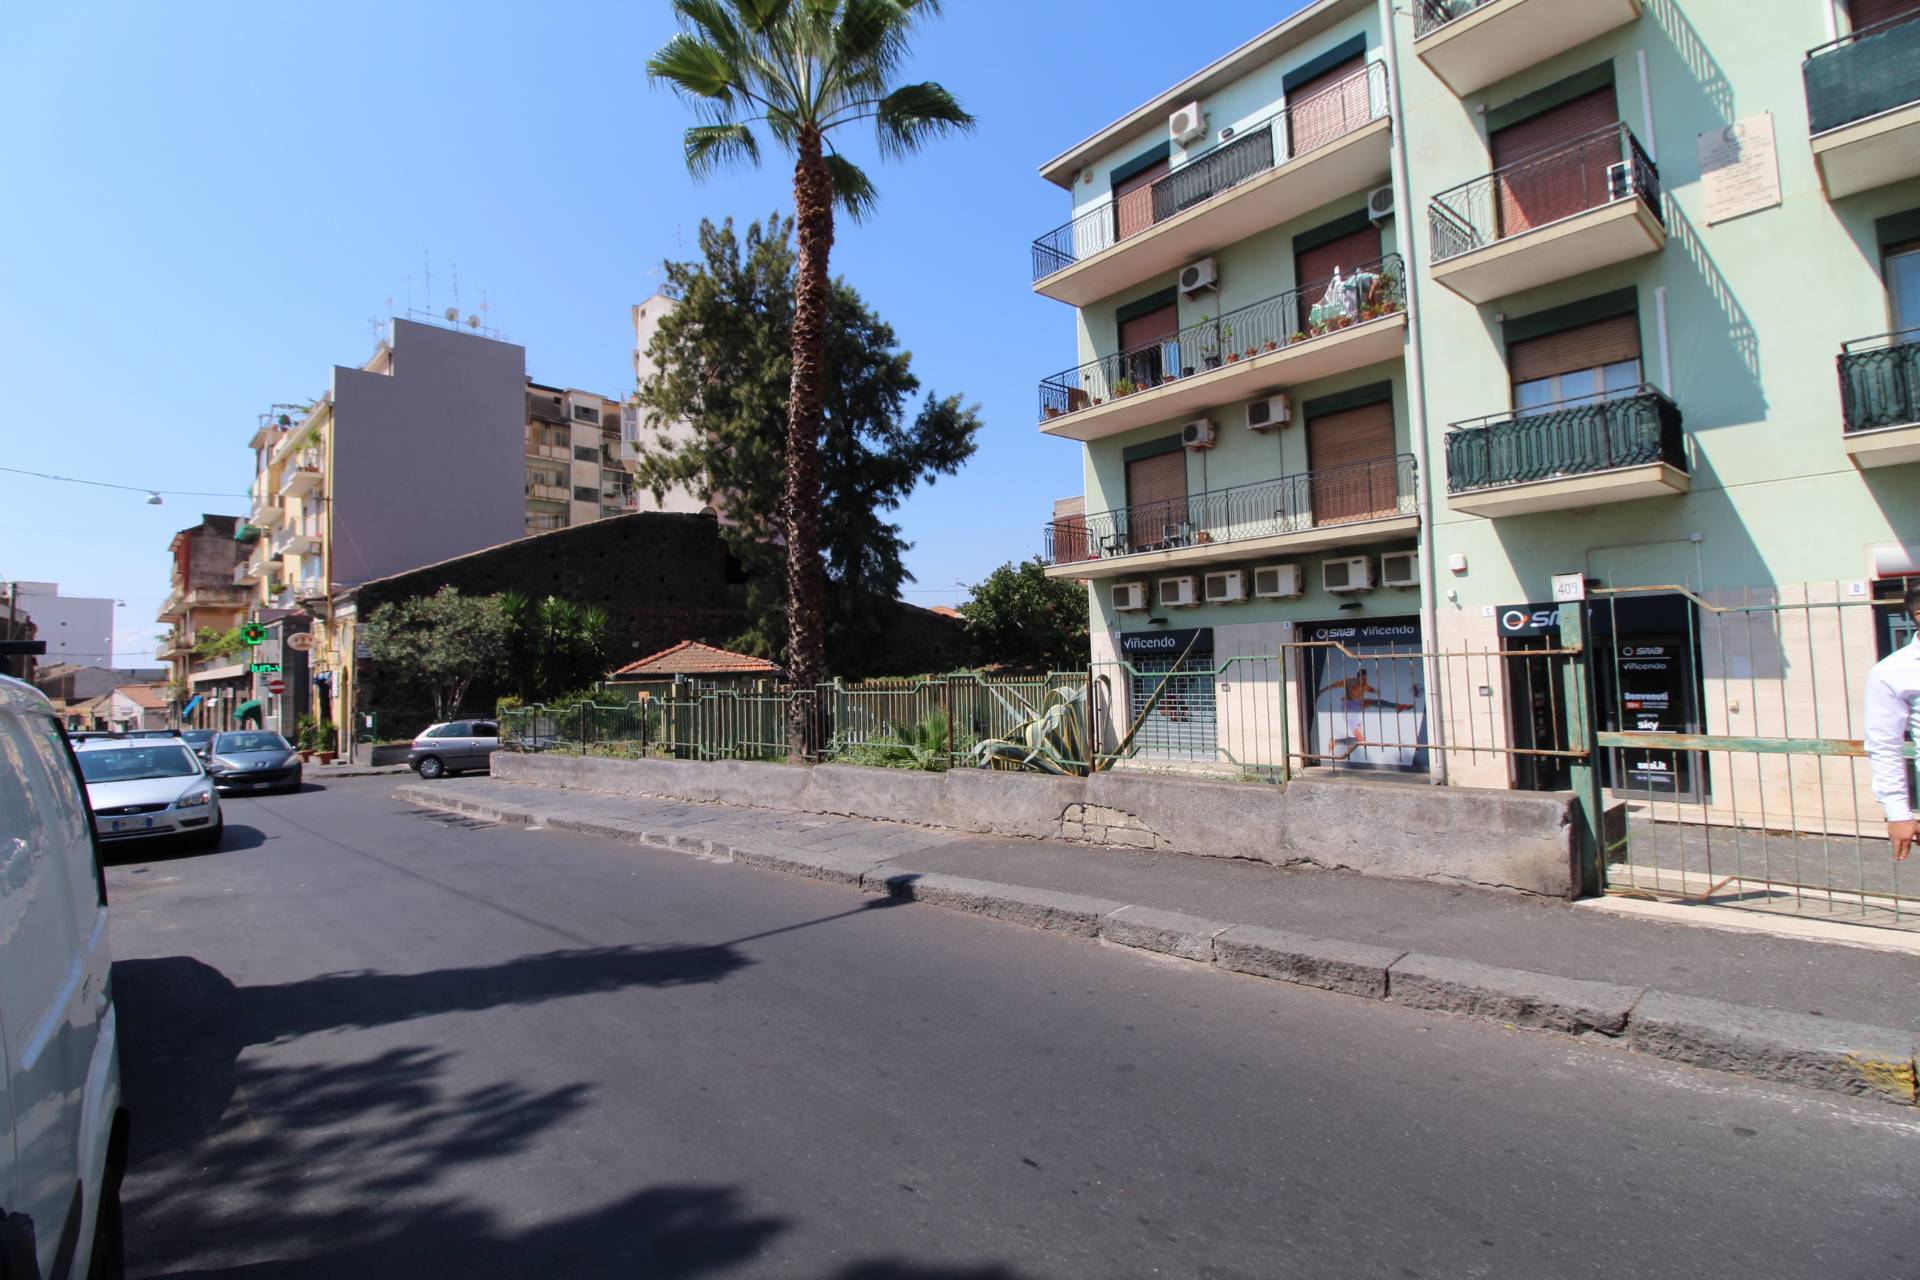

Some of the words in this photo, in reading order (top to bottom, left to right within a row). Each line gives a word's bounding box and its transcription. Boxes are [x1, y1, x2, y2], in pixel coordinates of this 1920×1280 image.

[1558, 582, 1578, 596] 409
[1624, 691, 1669, 701] Benvenuti
[1637, 720, 1659, 731] sky
